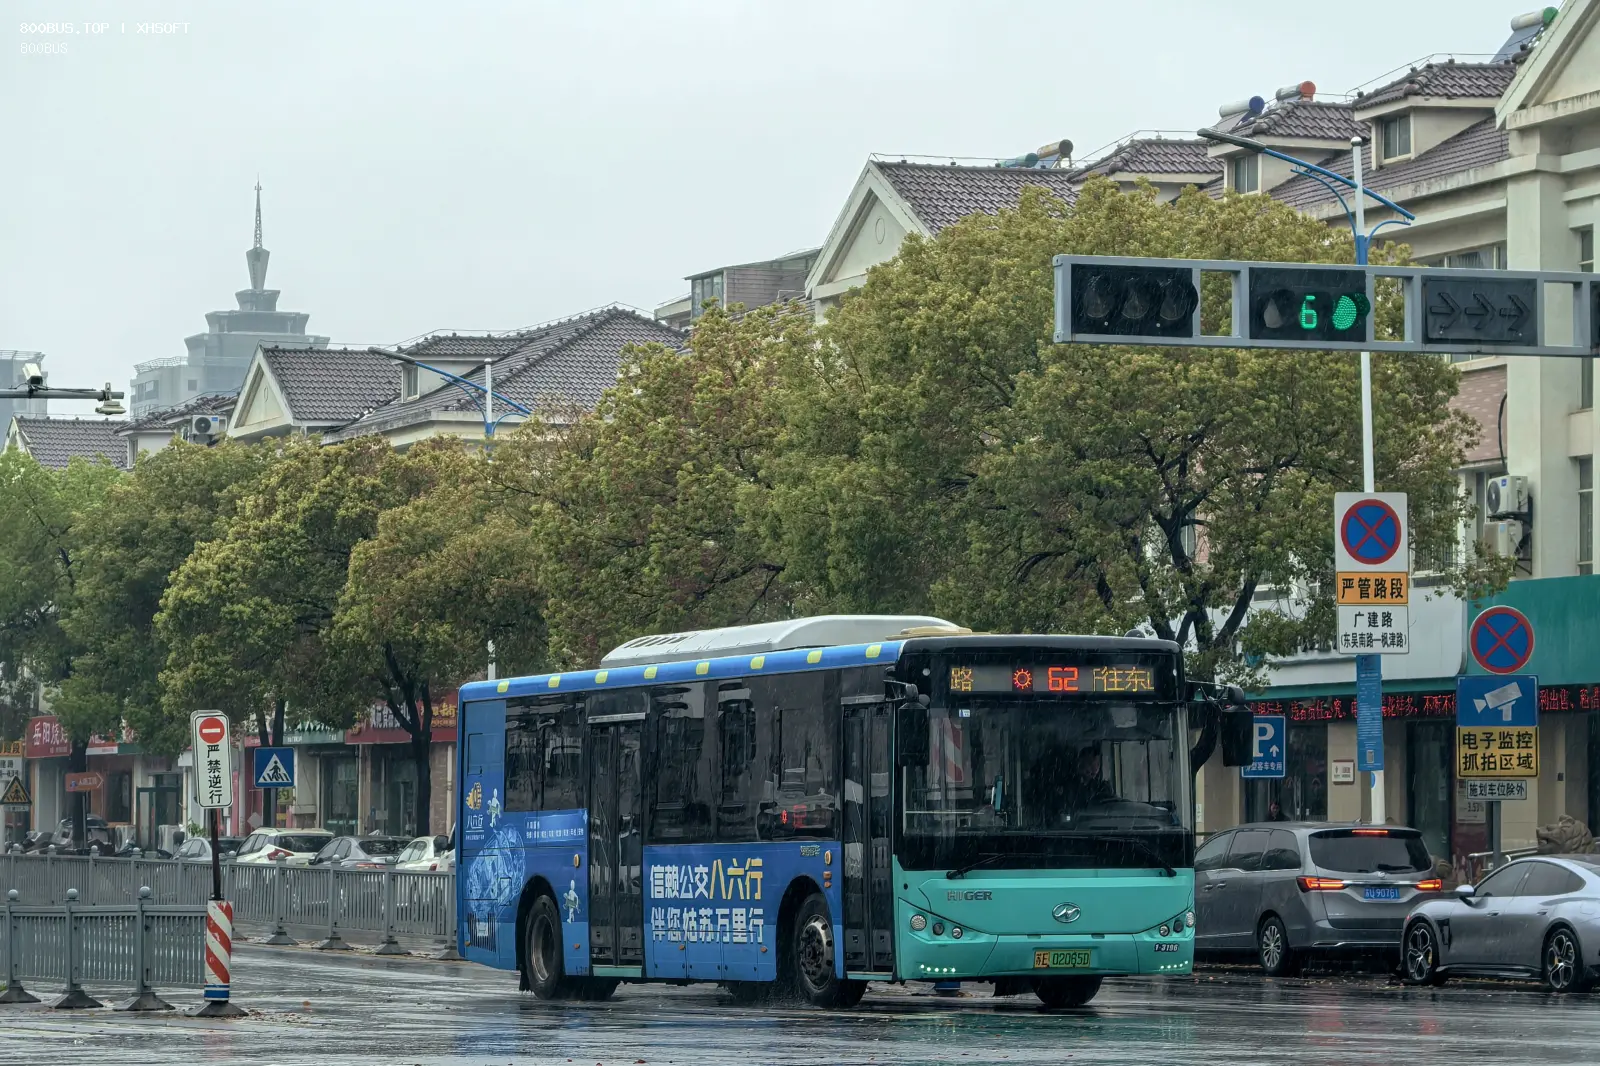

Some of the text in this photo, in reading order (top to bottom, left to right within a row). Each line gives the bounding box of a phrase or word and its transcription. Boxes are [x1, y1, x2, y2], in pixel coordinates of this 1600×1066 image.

[1301, 295, 1317, 329] 6
[1341, 577, 1403, 599] 严管路段
[1354, 611, 1393, 628] 广建路
[950, 666, 973, 691] 路
[1047, 667, 1079, 691] 62
[1462, 731, 1533, 749] 电子监控
[1462, 753, 1534, 771] 抓拍区域
[207, 744, 222, 804] 严禁逆行
[1469, 783, 1525, 797] 施划车位除外
[947, 890, 993, 901] HIGER
[650, 907, 764, 944] 伴您姑苏万里行
